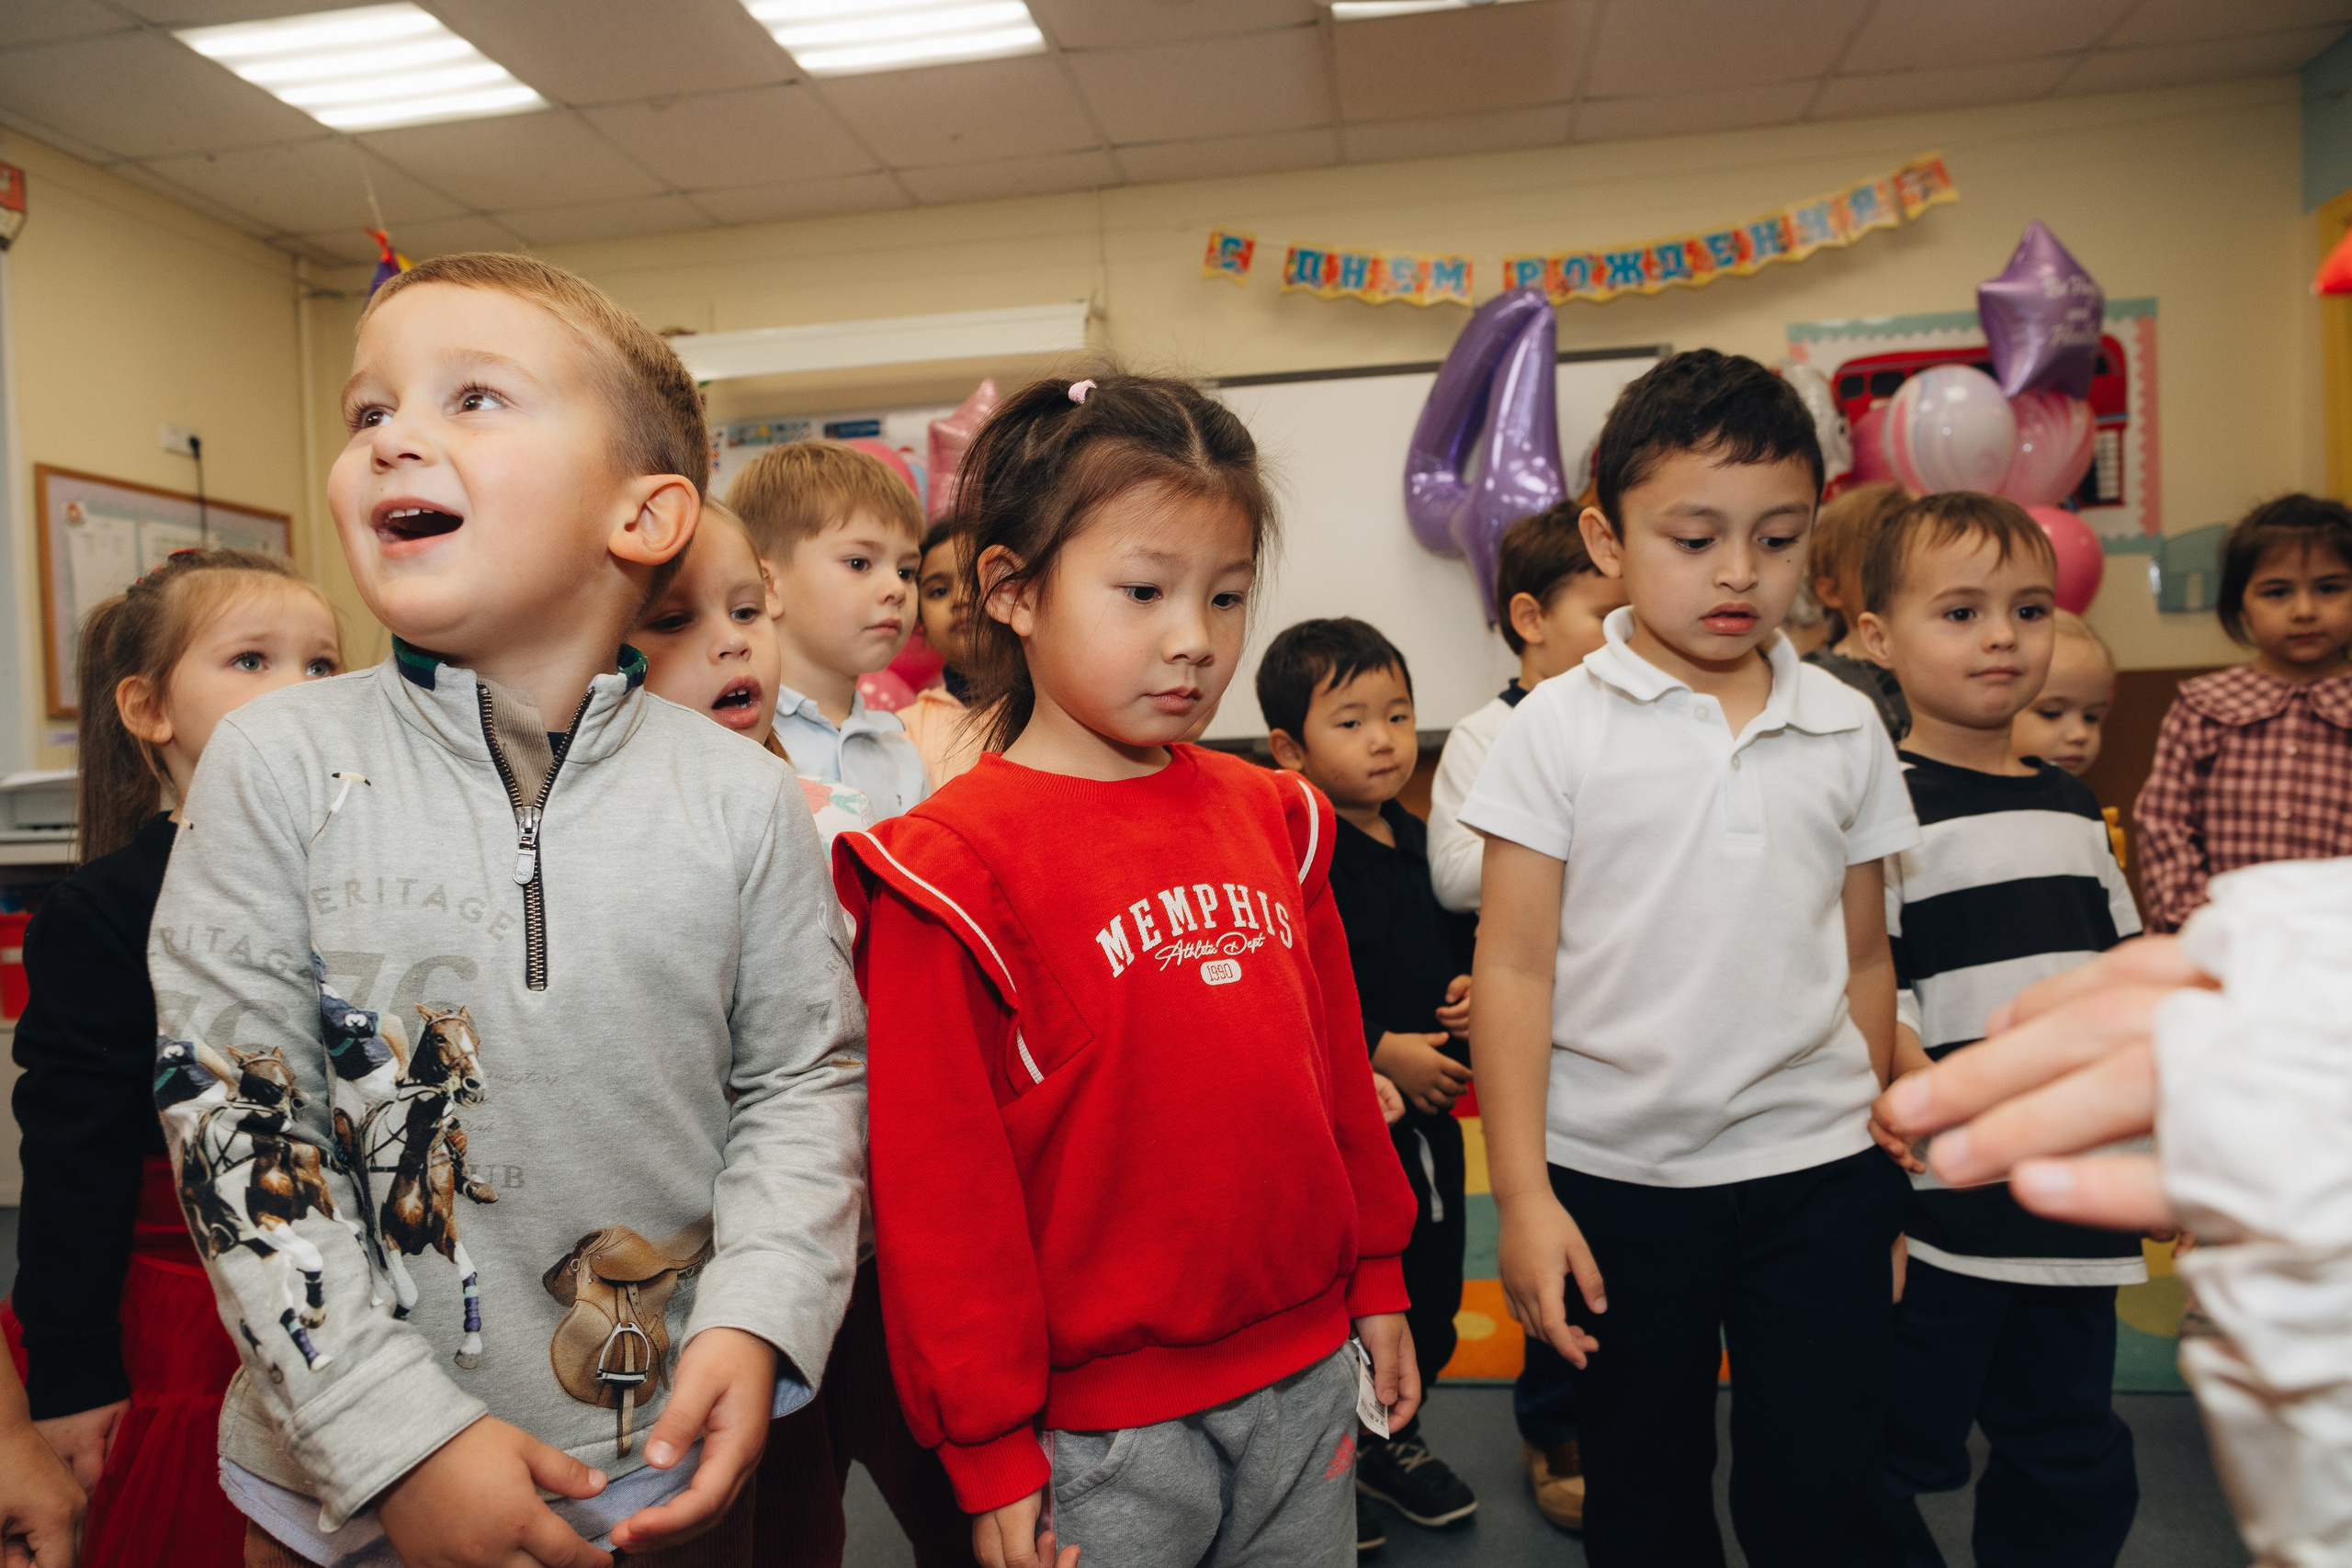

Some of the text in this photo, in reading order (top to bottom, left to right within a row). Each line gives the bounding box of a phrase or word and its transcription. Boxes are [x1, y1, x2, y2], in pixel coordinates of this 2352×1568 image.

[1220, 236, 1242, 271] С
[1295, 249, 1467, 294] ДНЕМ
[311, 876, 516, 942] ERITAGE
[1095, 883, 1293, 979] MEMPHIS
[1206, 963, 1234, 982] 1990
